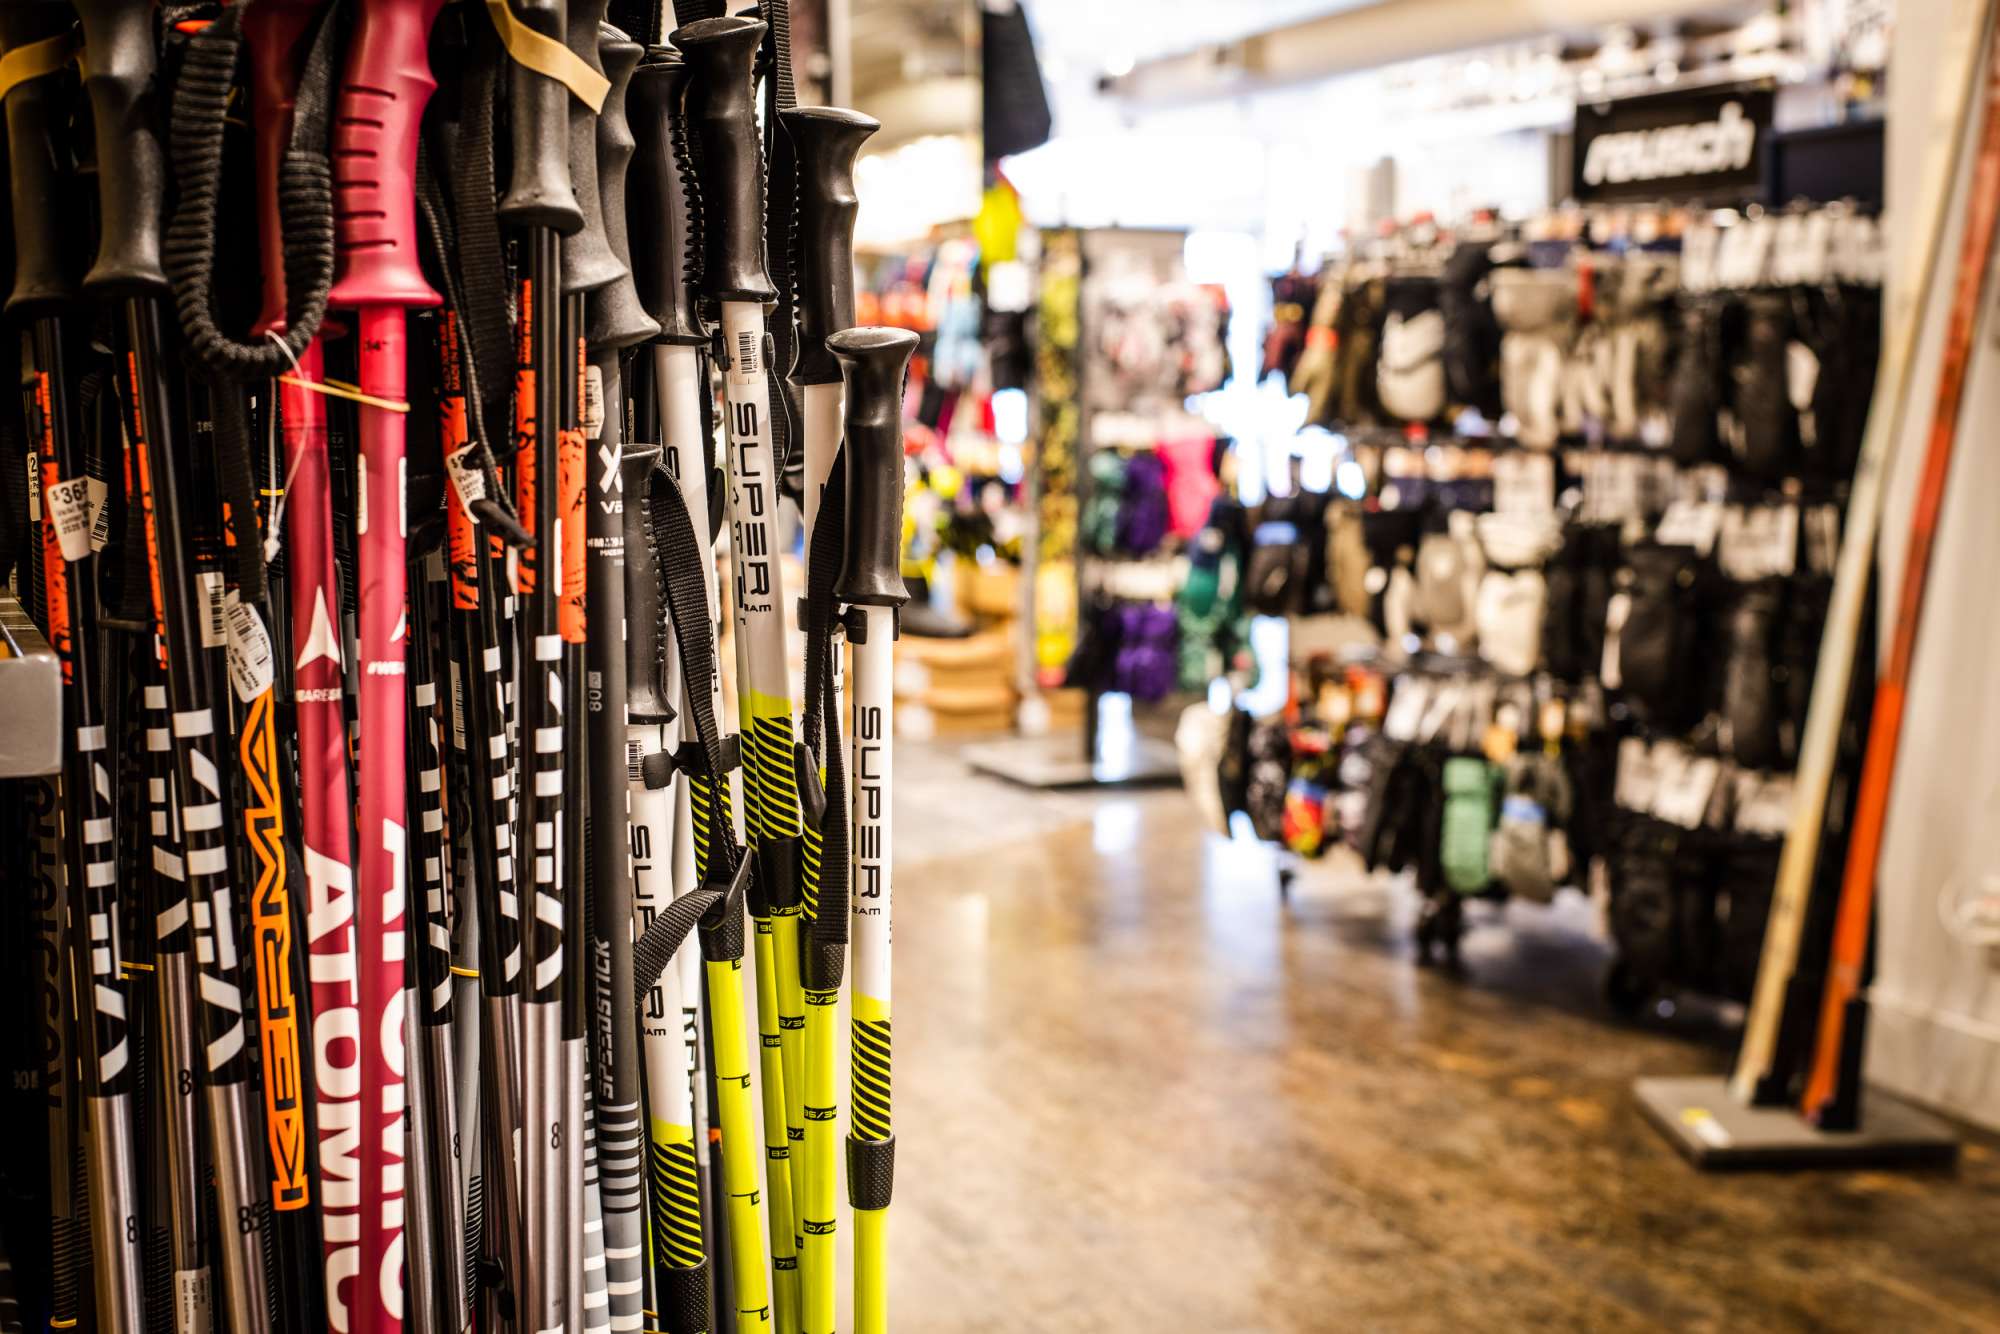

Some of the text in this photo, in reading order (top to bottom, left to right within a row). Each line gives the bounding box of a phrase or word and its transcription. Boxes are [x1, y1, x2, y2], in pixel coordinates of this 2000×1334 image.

[736, 402, 770, 596] SUPER
[588, 689, 602, 712] 80
[861, 705, 881, 899] SUPER
[240, 686, 309, 1211] KERMA
[594, 936, 615, 1100] SPEEDSTICK
[630, 824, 664, 1020] SUPR
[304, 843, 360, 1334] ATOMIC
